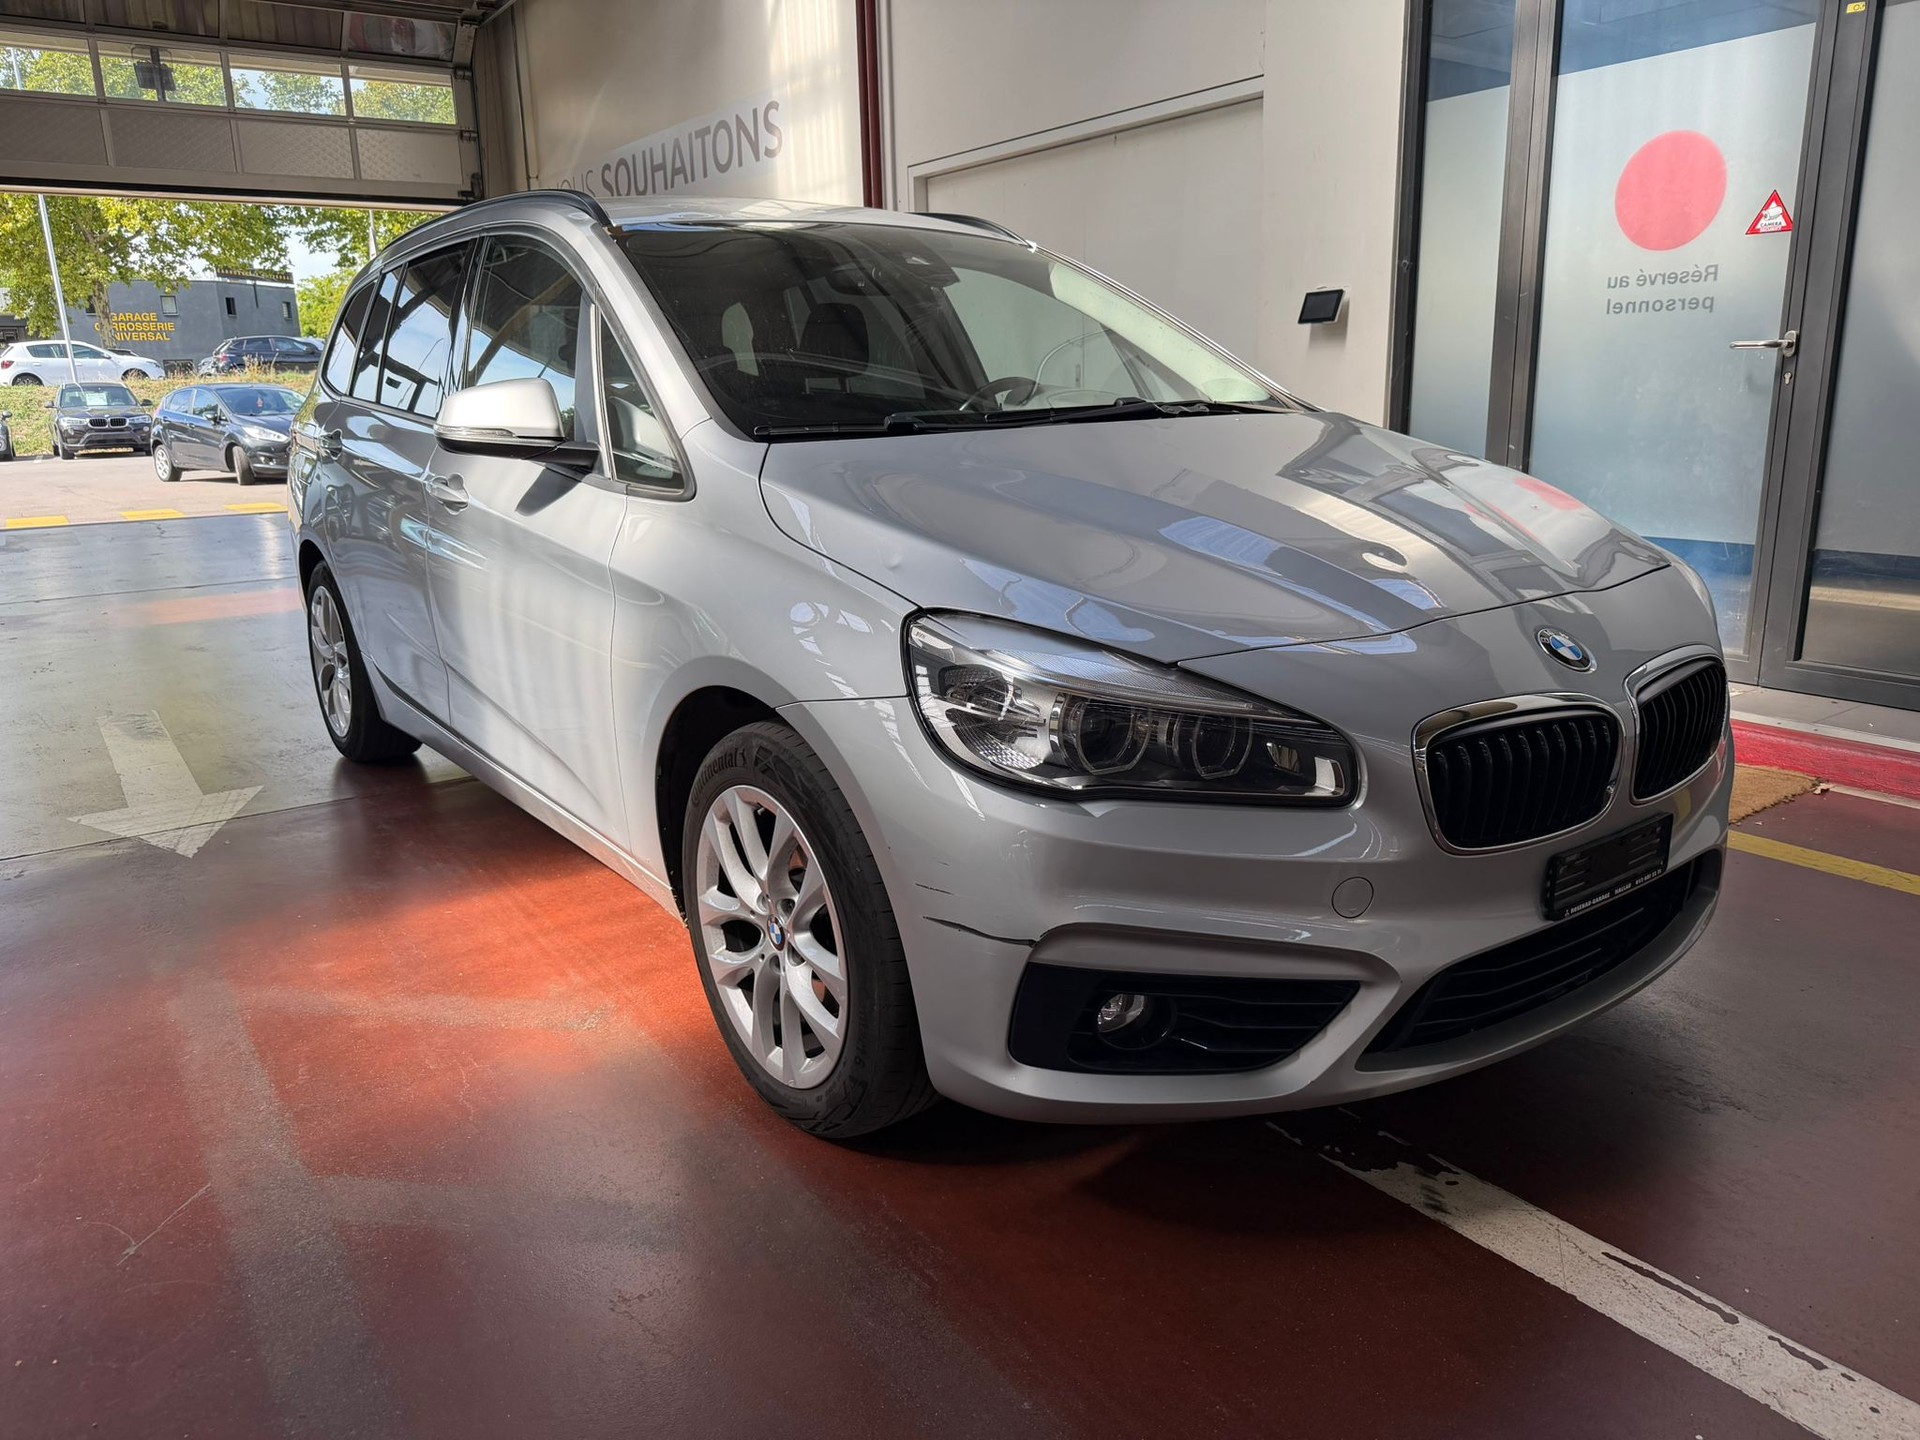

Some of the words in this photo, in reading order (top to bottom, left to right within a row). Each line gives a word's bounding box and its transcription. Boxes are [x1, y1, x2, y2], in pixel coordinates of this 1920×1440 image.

[556, 170, 596, 197] OUS
[601, 101, 783, 197] SOUHAITONS
[111, 312, 157, 321] GARAGE
[94, 322, 175, 331] CRROSSERIE
[114, 332, 171, 341] NIVERSAL
[690, 747, 738, 807] Continental
